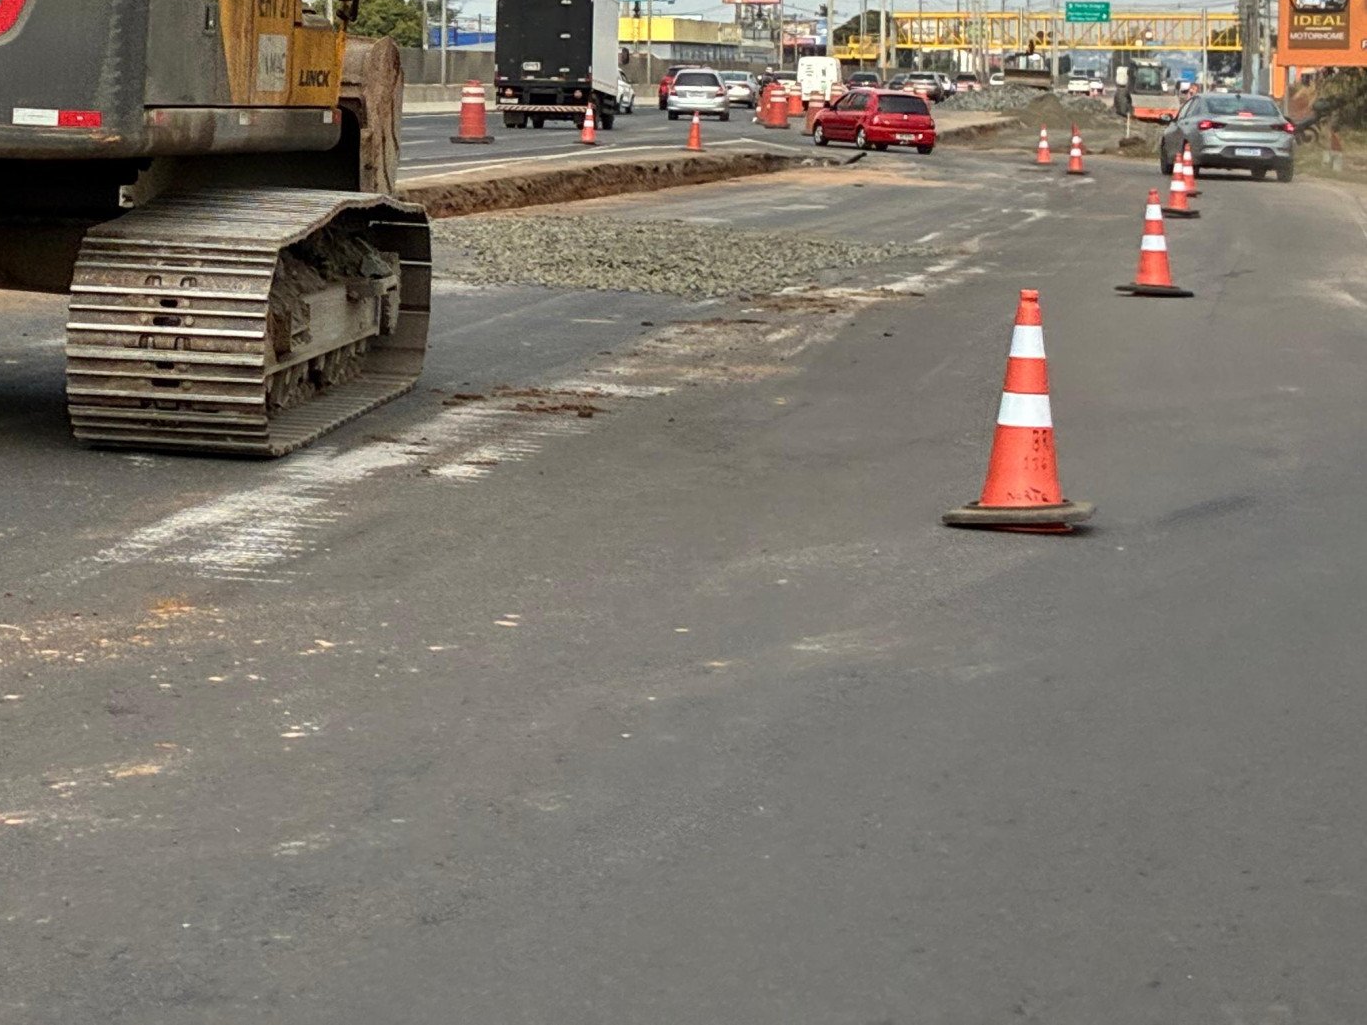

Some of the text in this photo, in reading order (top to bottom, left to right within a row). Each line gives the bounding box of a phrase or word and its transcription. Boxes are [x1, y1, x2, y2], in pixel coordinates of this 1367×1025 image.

[1294, 15, 1346, 26] IDEAL
[1290, 32, 1345, 40] MOTORHOME
[298, 69, 331, 88] LINCK
